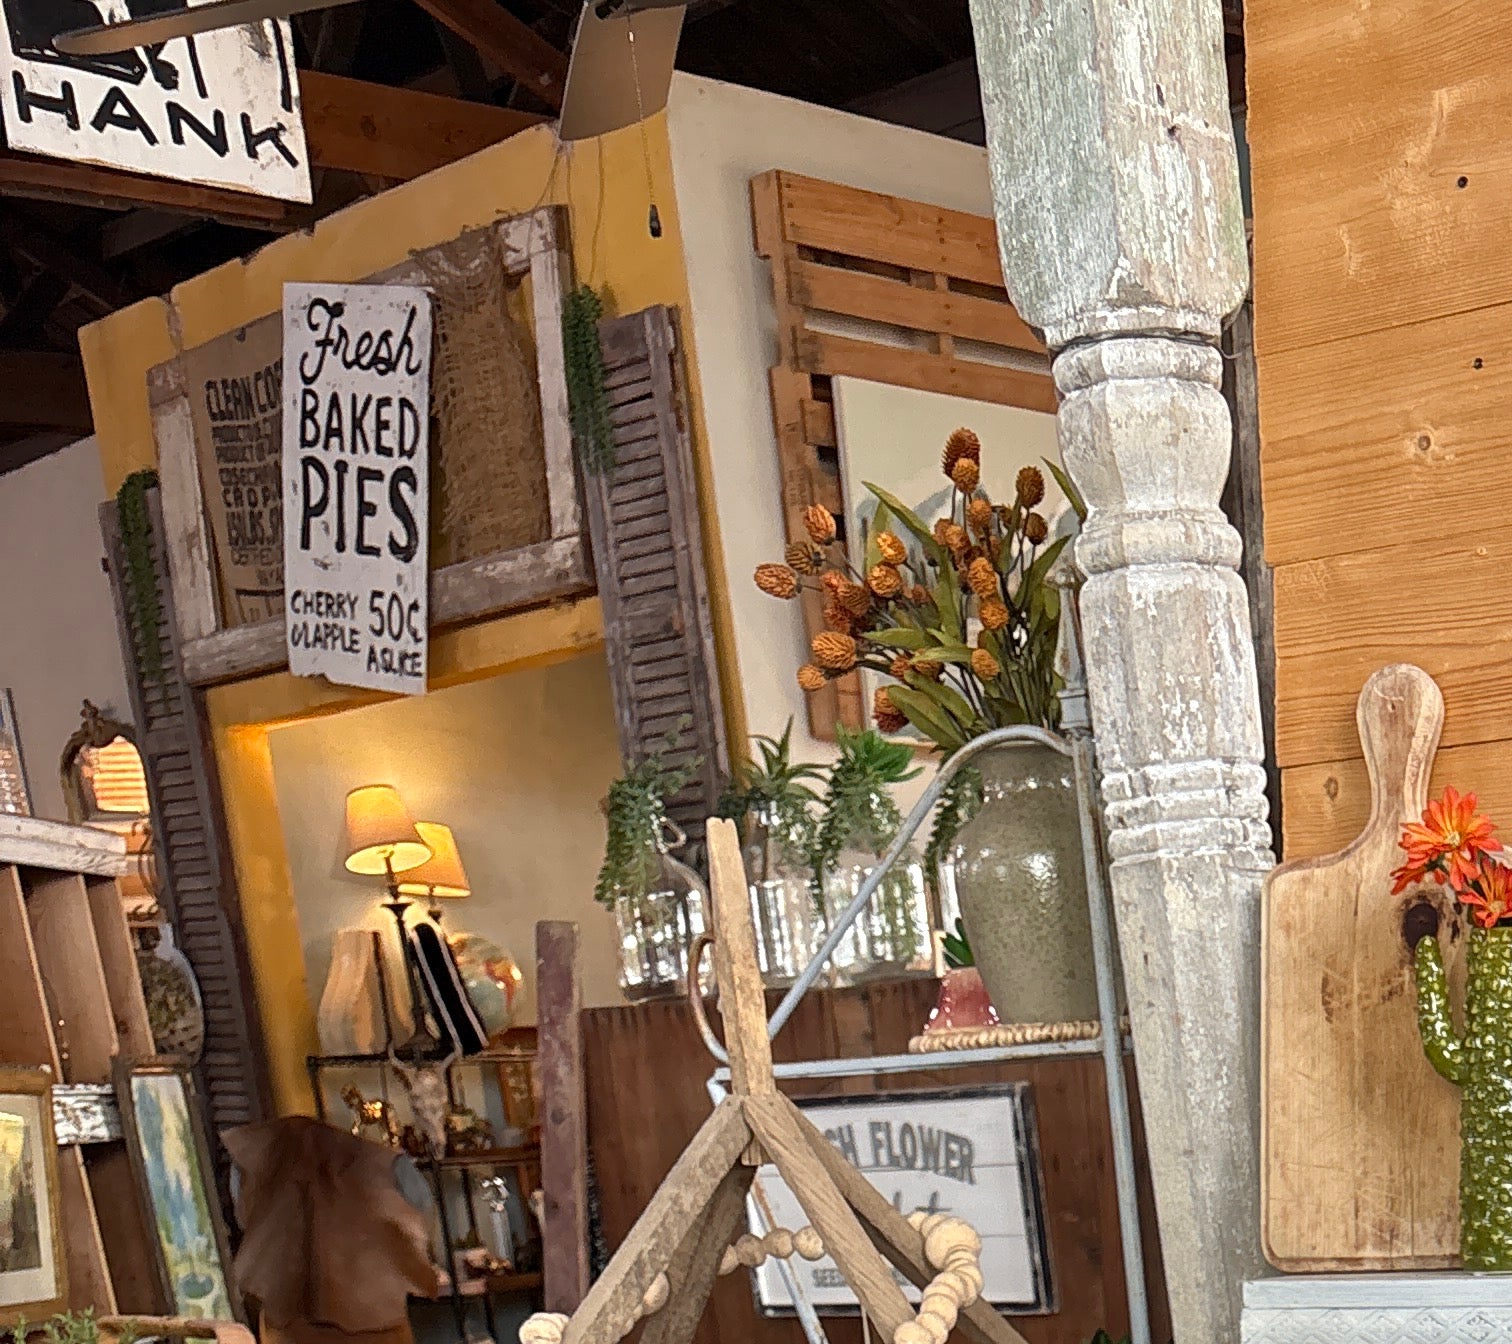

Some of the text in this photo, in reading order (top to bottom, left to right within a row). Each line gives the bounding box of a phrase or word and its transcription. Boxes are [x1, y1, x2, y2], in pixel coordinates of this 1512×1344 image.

[12, 70, 298, 168] HANK
[299, 297, 422, 385] Fresh
[299, 388, 421, 460] BAKED
[300, 456, 419, 563] PIES
[290, 589, 359, 620] CHERRY
[312, 622, 361, 653] APPLE
[869, 1121, 977, 1186] FLOWER
